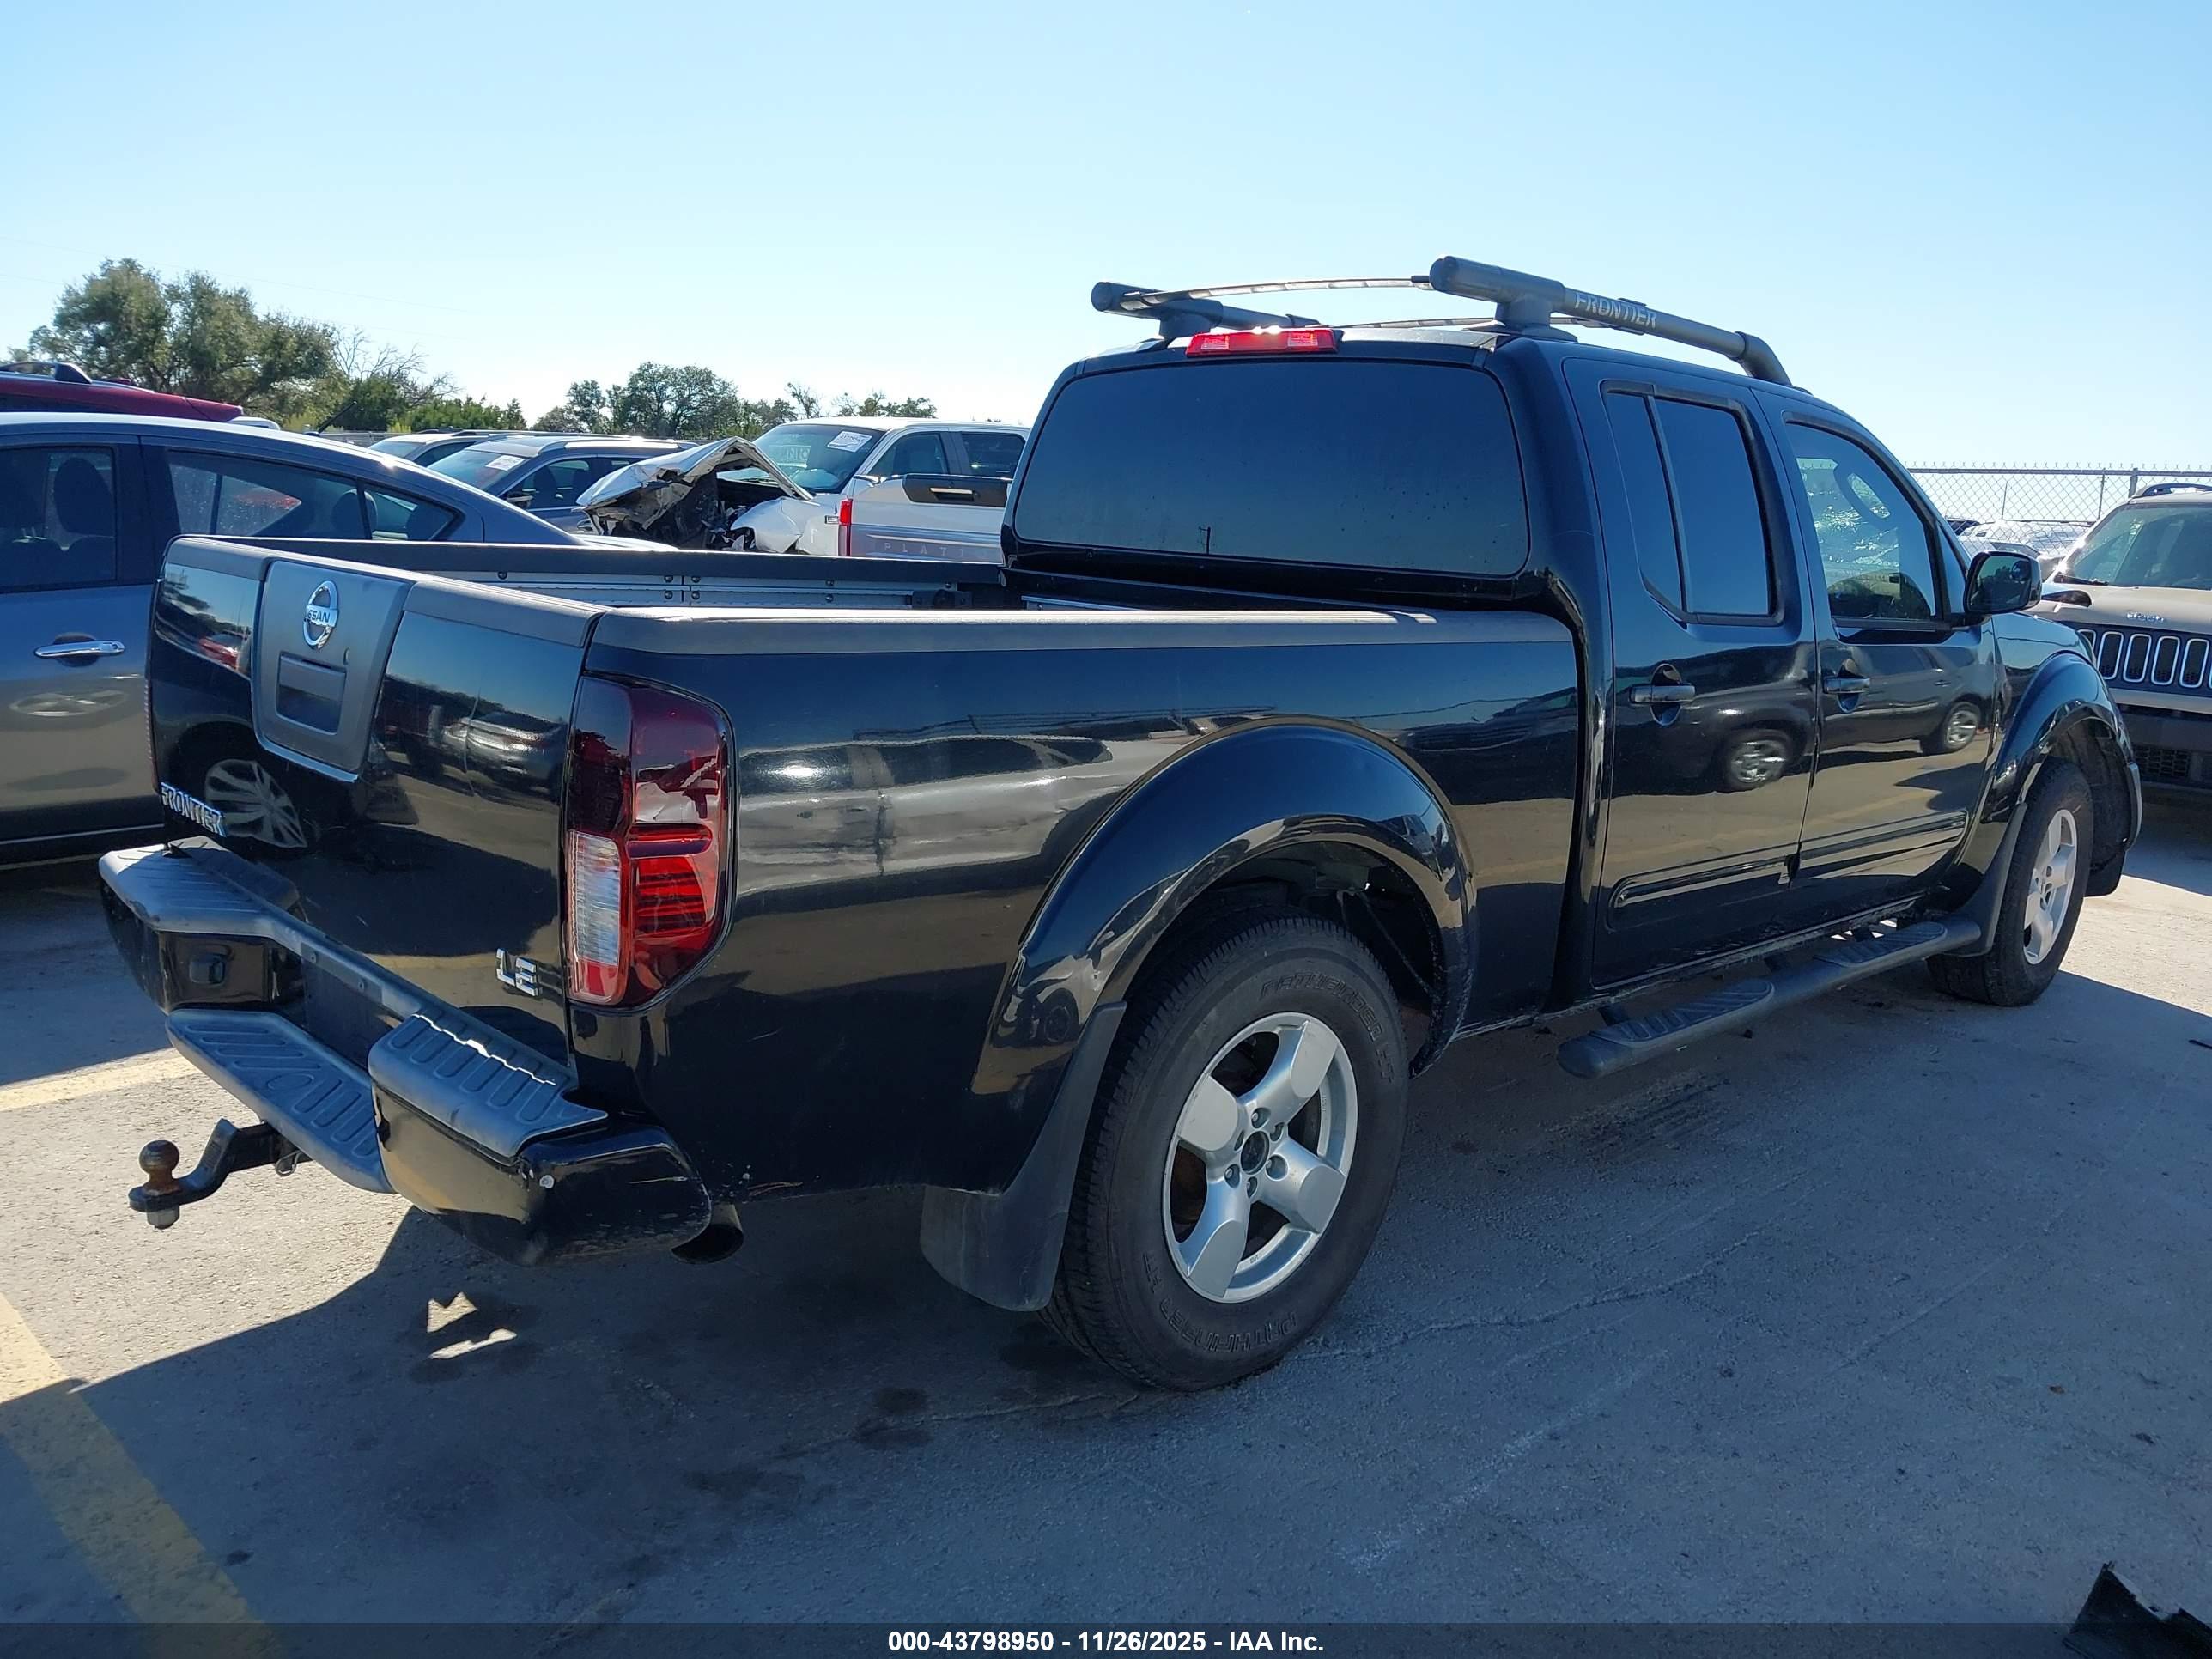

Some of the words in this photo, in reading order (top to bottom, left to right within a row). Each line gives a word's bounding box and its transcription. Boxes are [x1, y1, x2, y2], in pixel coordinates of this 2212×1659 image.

[1574, 292, 1657, 329] FRONTIER
[307, 608, 331, 624] SSAN
[161, 781, 227, 838] FRONTIER
[495, 947, 538, 997] LE
